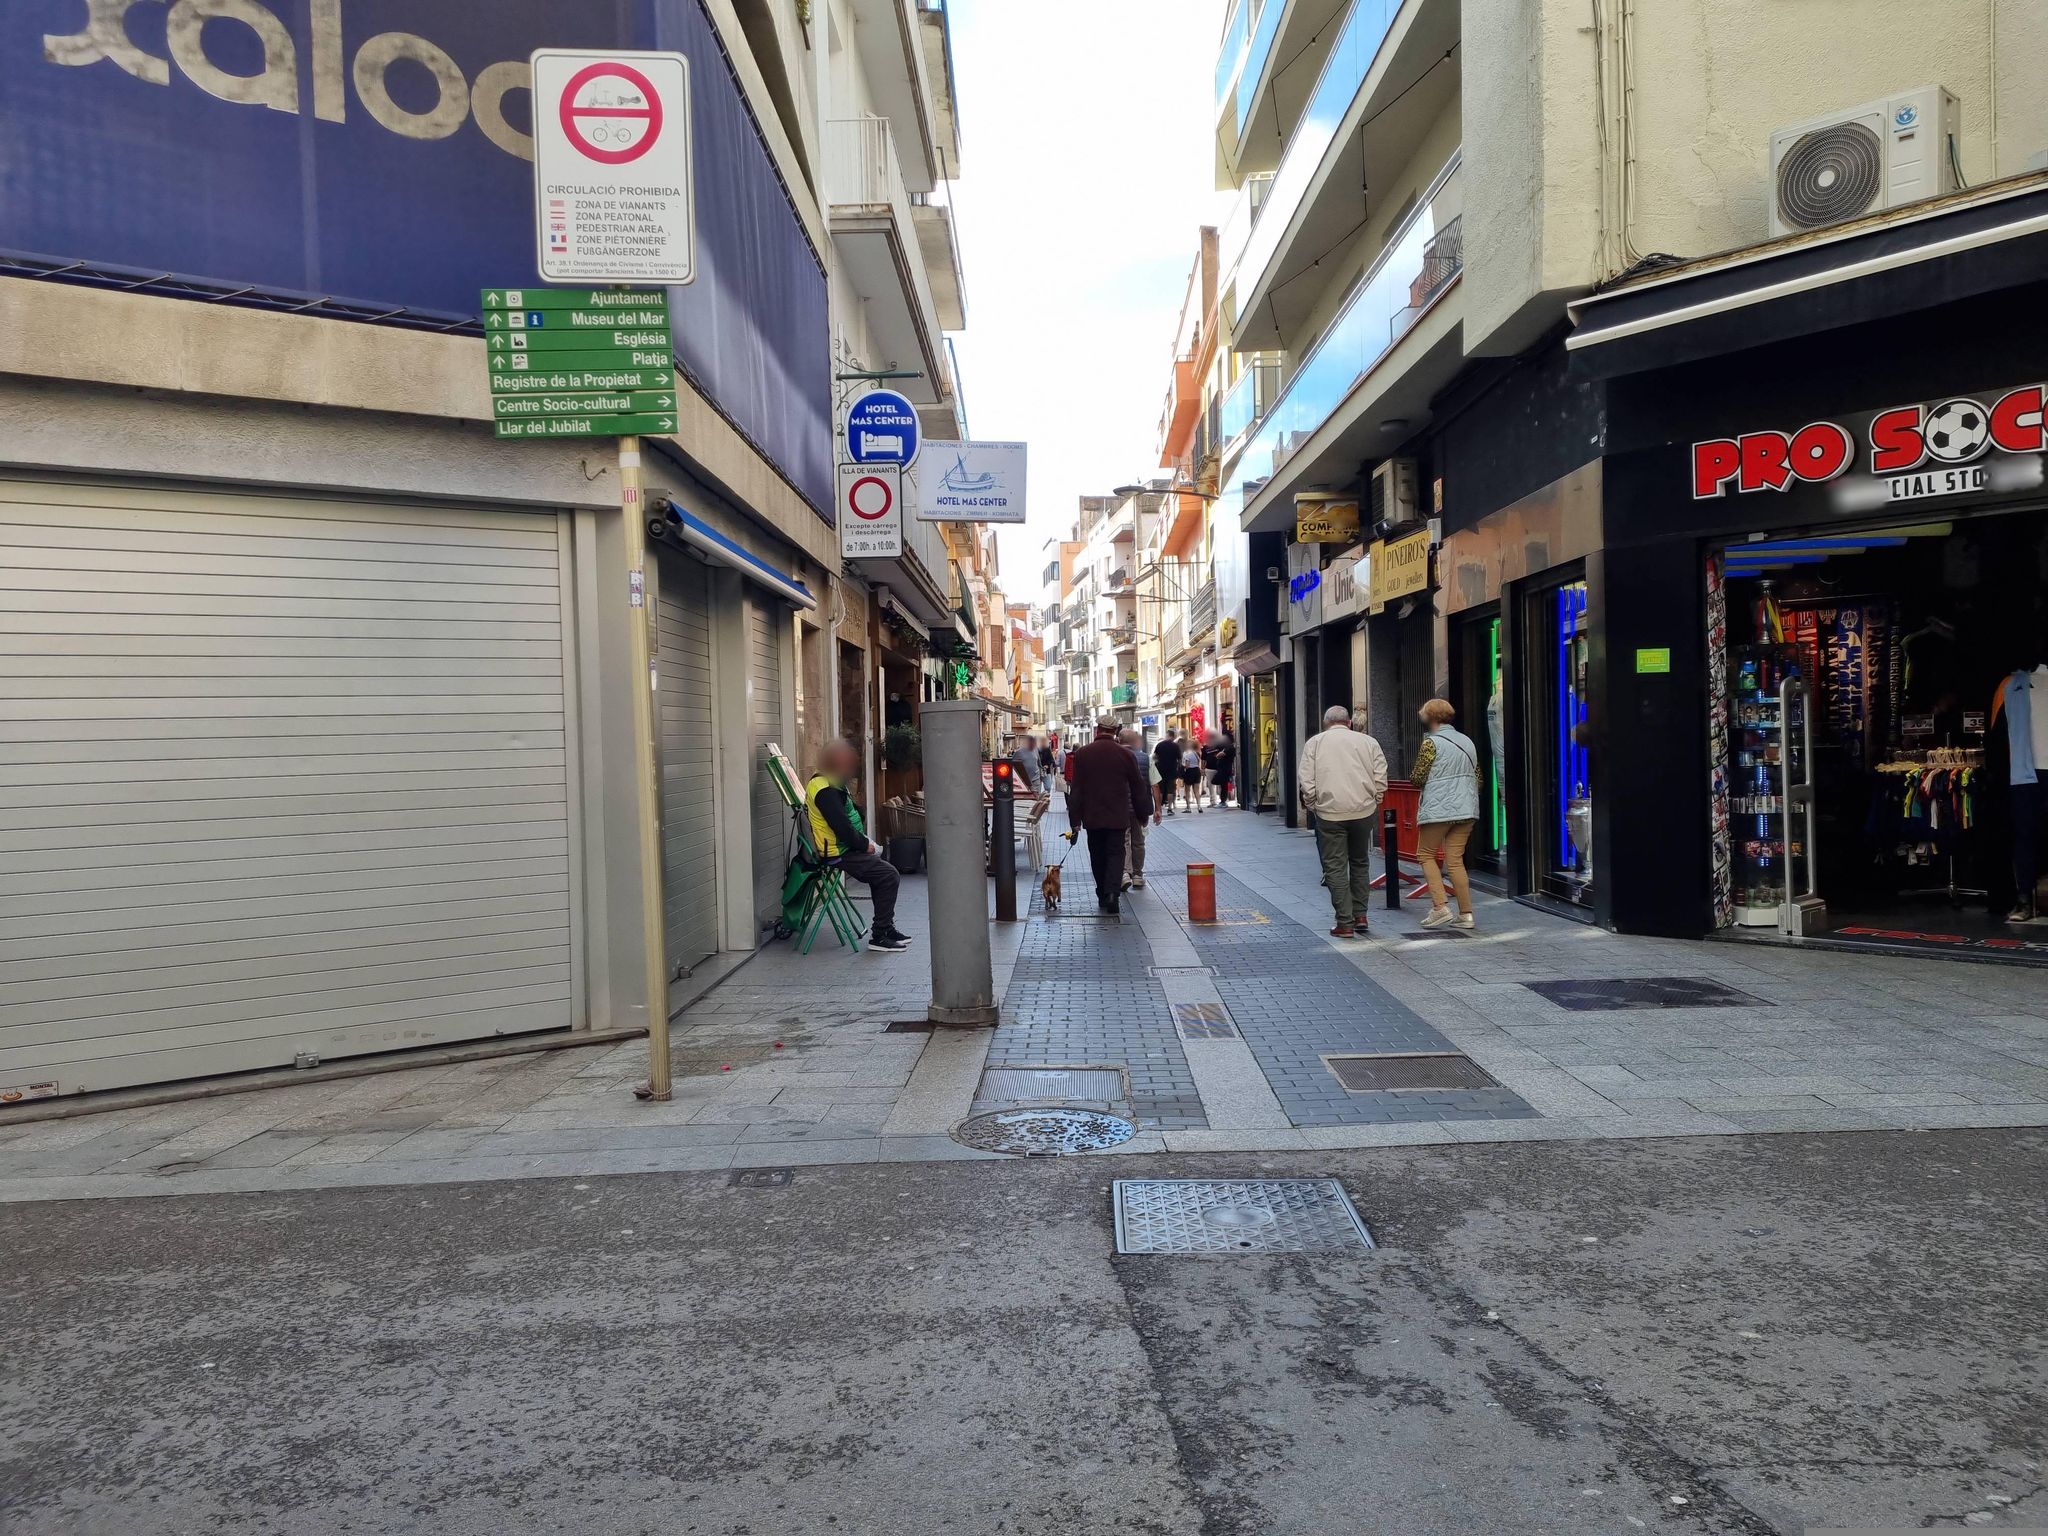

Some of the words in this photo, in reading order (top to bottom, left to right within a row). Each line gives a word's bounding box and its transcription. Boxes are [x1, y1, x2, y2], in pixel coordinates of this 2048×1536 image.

[547, 184, 616, 195] CIRCULACIÓ
[619, 186, 680, 196] PROHIBIDA
[575, 200, 601, 209] ZONA
[604, 201, 616, 209] DE
[619, 202, 666, 210] VIANANTS
[576, 212, 602, 221] ZONA
[604, 213, 654, 222] PEATONAL
[576, 224, 636, 233] PEDESTRIAN
[638, 224, 664, 233] AREA
[576, 236, 602, 244] ZONE
[573, 260, 608, 268] Ordenança
[590, 291, 663, 307] Ajuntament
[572, 312, 614, 326] Museu
[618, 312, 636, 325] del
[640, 313, 664, 325] Mar
[614, 332, 666, 347] Església
[632, 352, 668, 368] Platja
[494, 375, 547, 391] Registre
[551, 374, 567, 387] de
[570, 374, 580, 386] la
[584, 373, 641, 389] Propietat
[497, 400, 540, 412] Centre
[543, 397, 630, 411] Socio-cultural
[866, 405, 898, 414] HOTEL
[851, 417, 872, 425] MAS
[874, 416, 913, 425] CENTER
[500, 421, 522, 434] Llar
[527, 420, 546, 433] del
[549, 419, 591, 433] Jubilat
[1692, 422, 1854, 500] PRO
[842, 467, 856, 475] ILLA
[937, 497, 960, 506] HOTEL
[962, 497, 978, 506] MAS
[979, 497, 1008, 506] CENTER
[846, 542, 853, 552] de
